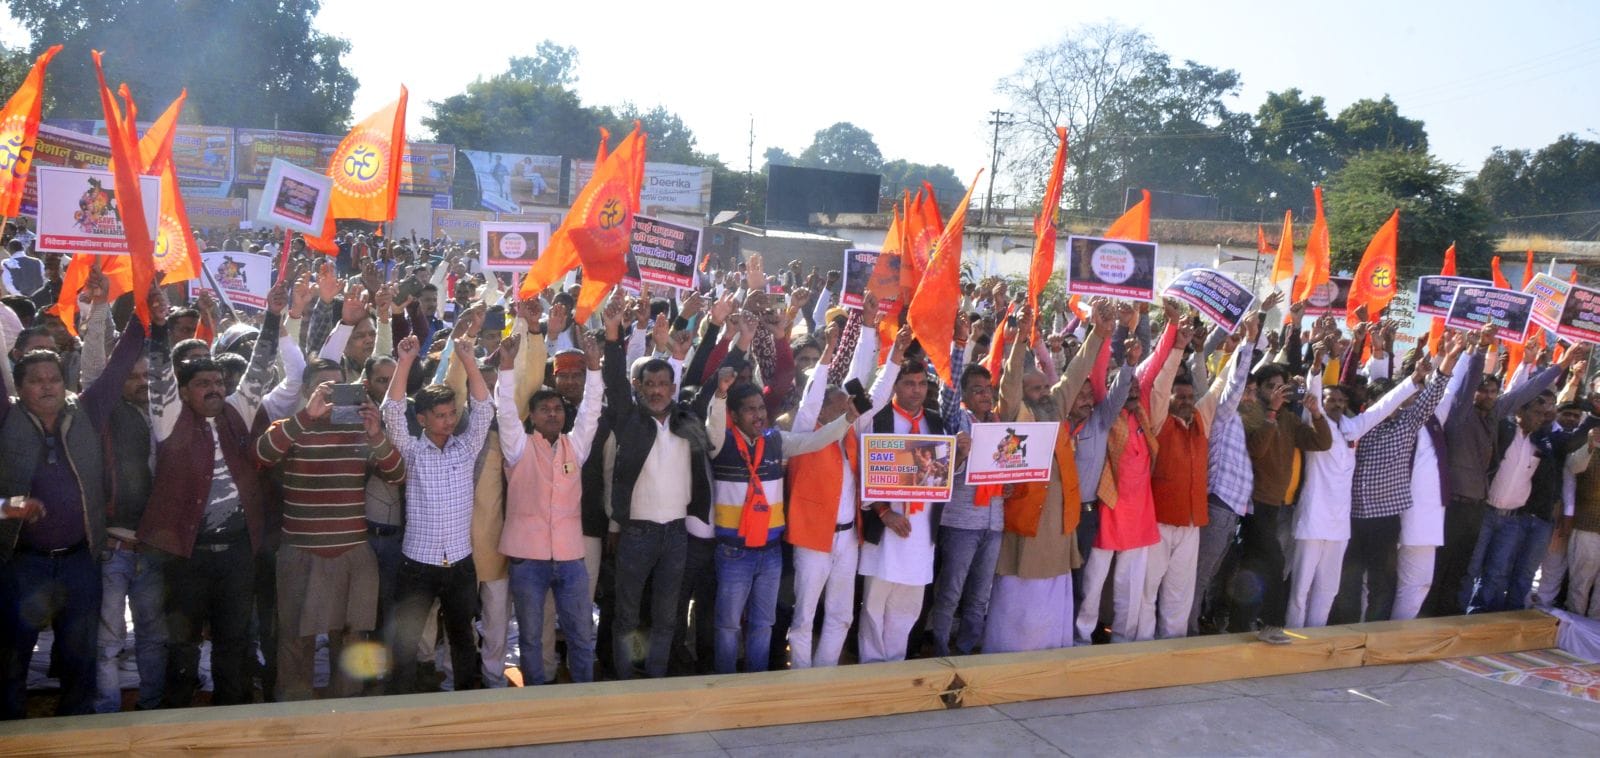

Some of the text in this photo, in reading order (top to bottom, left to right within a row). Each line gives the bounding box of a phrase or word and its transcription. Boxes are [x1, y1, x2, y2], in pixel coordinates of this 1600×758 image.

[74, 150, 110, 166] जनसभ
[650, 176, 690, 189] Deerika
[870, 440, 905, 449] PLEASE
[870, 452, 894, 461] SAVE
[870, 465, 918, 473] BANGLADESHI
[870, 475, 898, 483] HINDU
